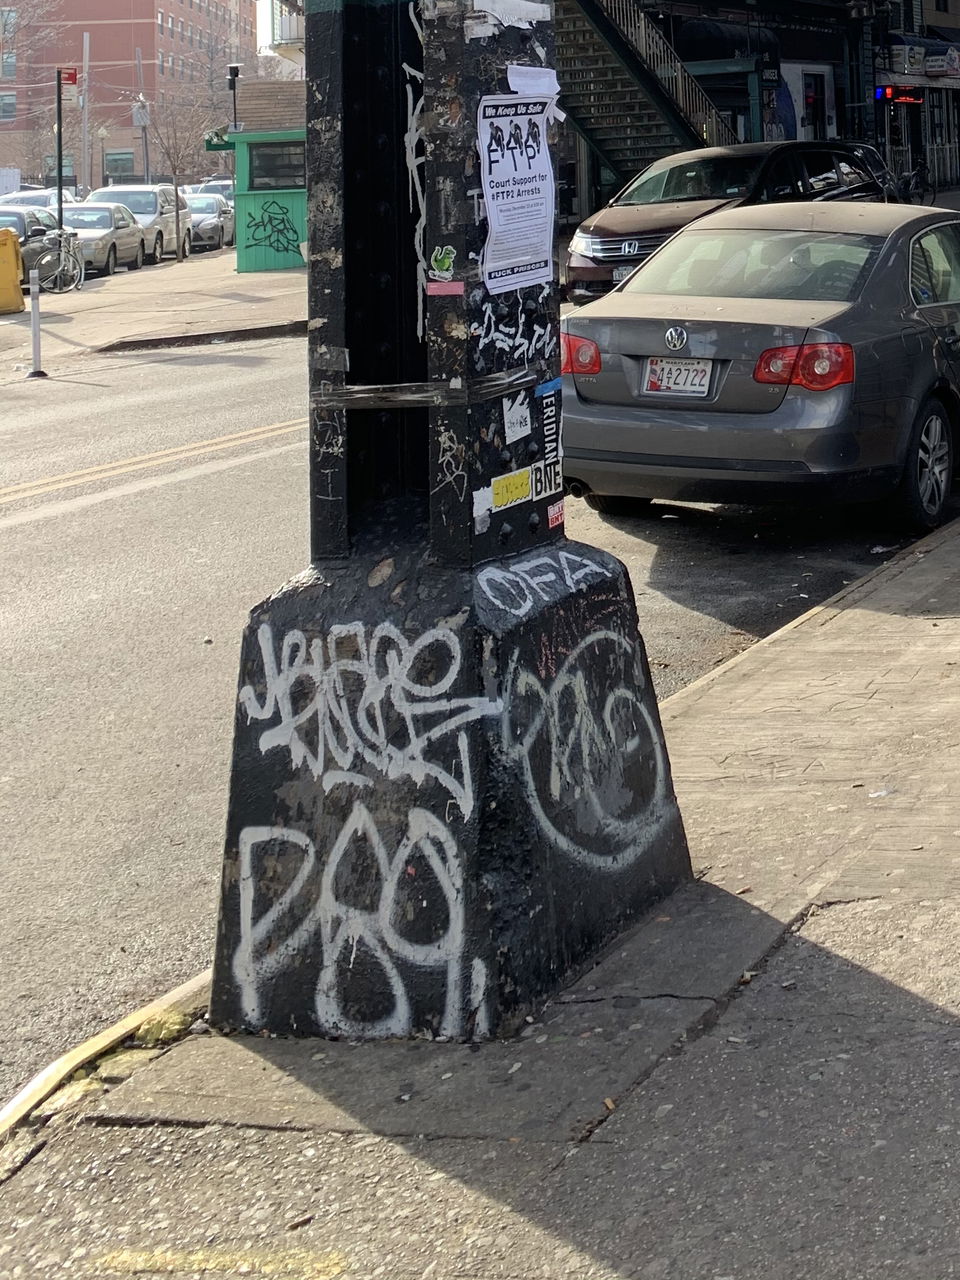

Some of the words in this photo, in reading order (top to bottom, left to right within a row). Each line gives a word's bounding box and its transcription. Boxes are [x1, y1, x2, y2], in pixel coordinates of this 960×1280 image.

[485, 106, 497, 117] We
[497, 106, 516, 116] Keep
[517, 104, 527, 114] Us
[527, 103, 543, 113] Safe
[489, 178, 510, 189] Court
[512, 174, 537, 186] Support
[538, 172, 548, 182] for
[492, 190, 515, 201] #FTP2
[516, 186, 541, 198] Arrests
[491, 268, 512, 279] FUCK
